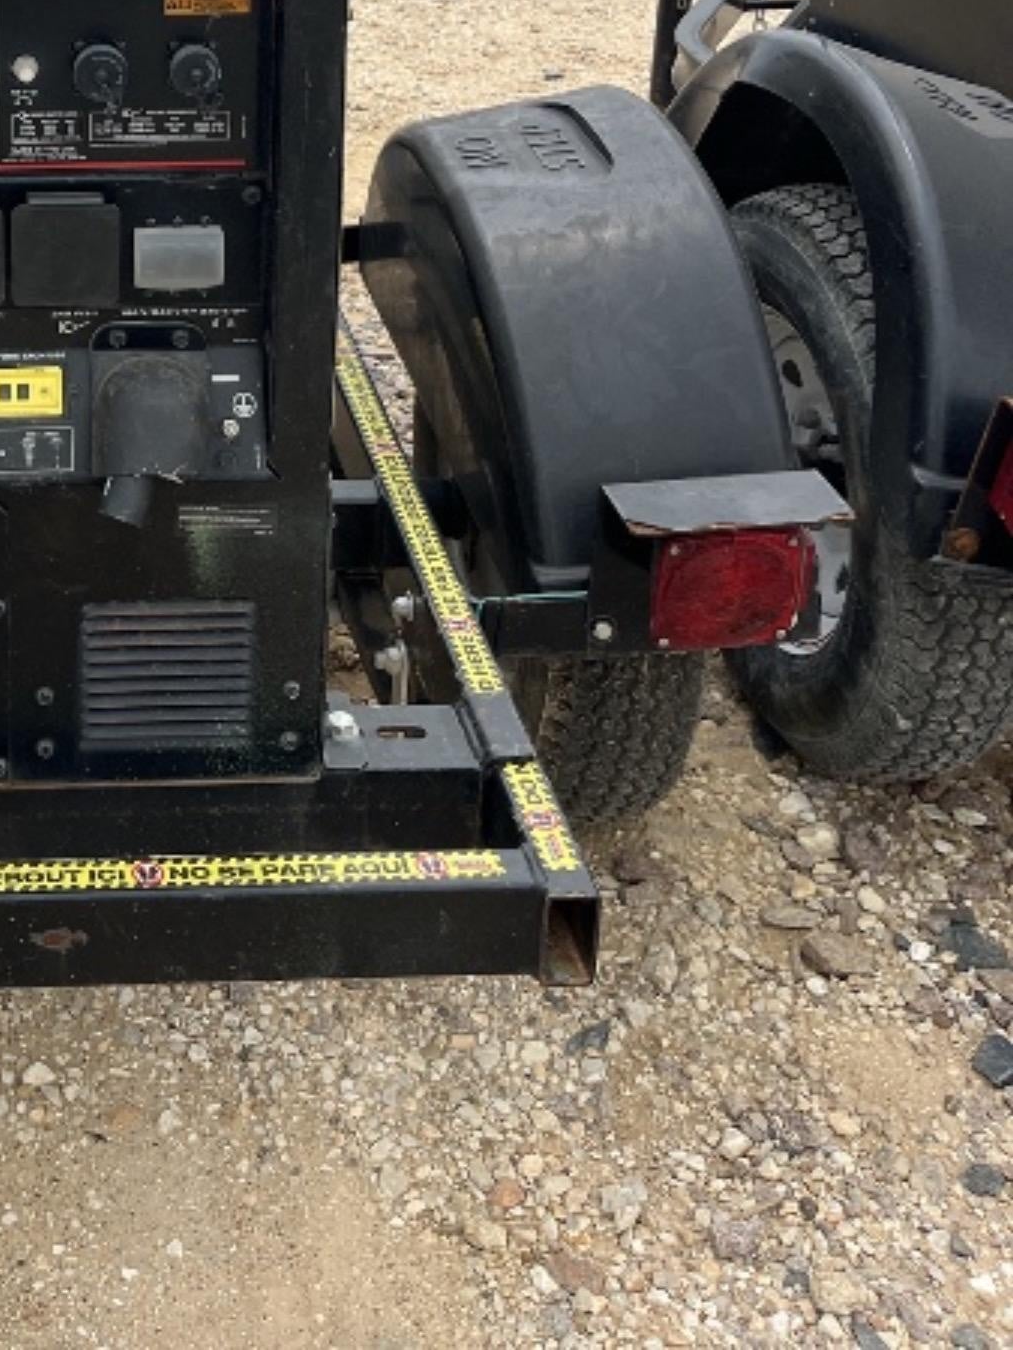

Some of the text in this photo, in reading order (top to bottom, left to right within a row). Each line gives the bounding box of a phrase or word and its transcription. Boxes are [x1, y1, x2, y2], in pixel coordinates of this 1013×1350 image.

[90, 866, 126, 882] ICI
[169, 865, 212, 880] NO
[262, 862, 336, 878] PARE
